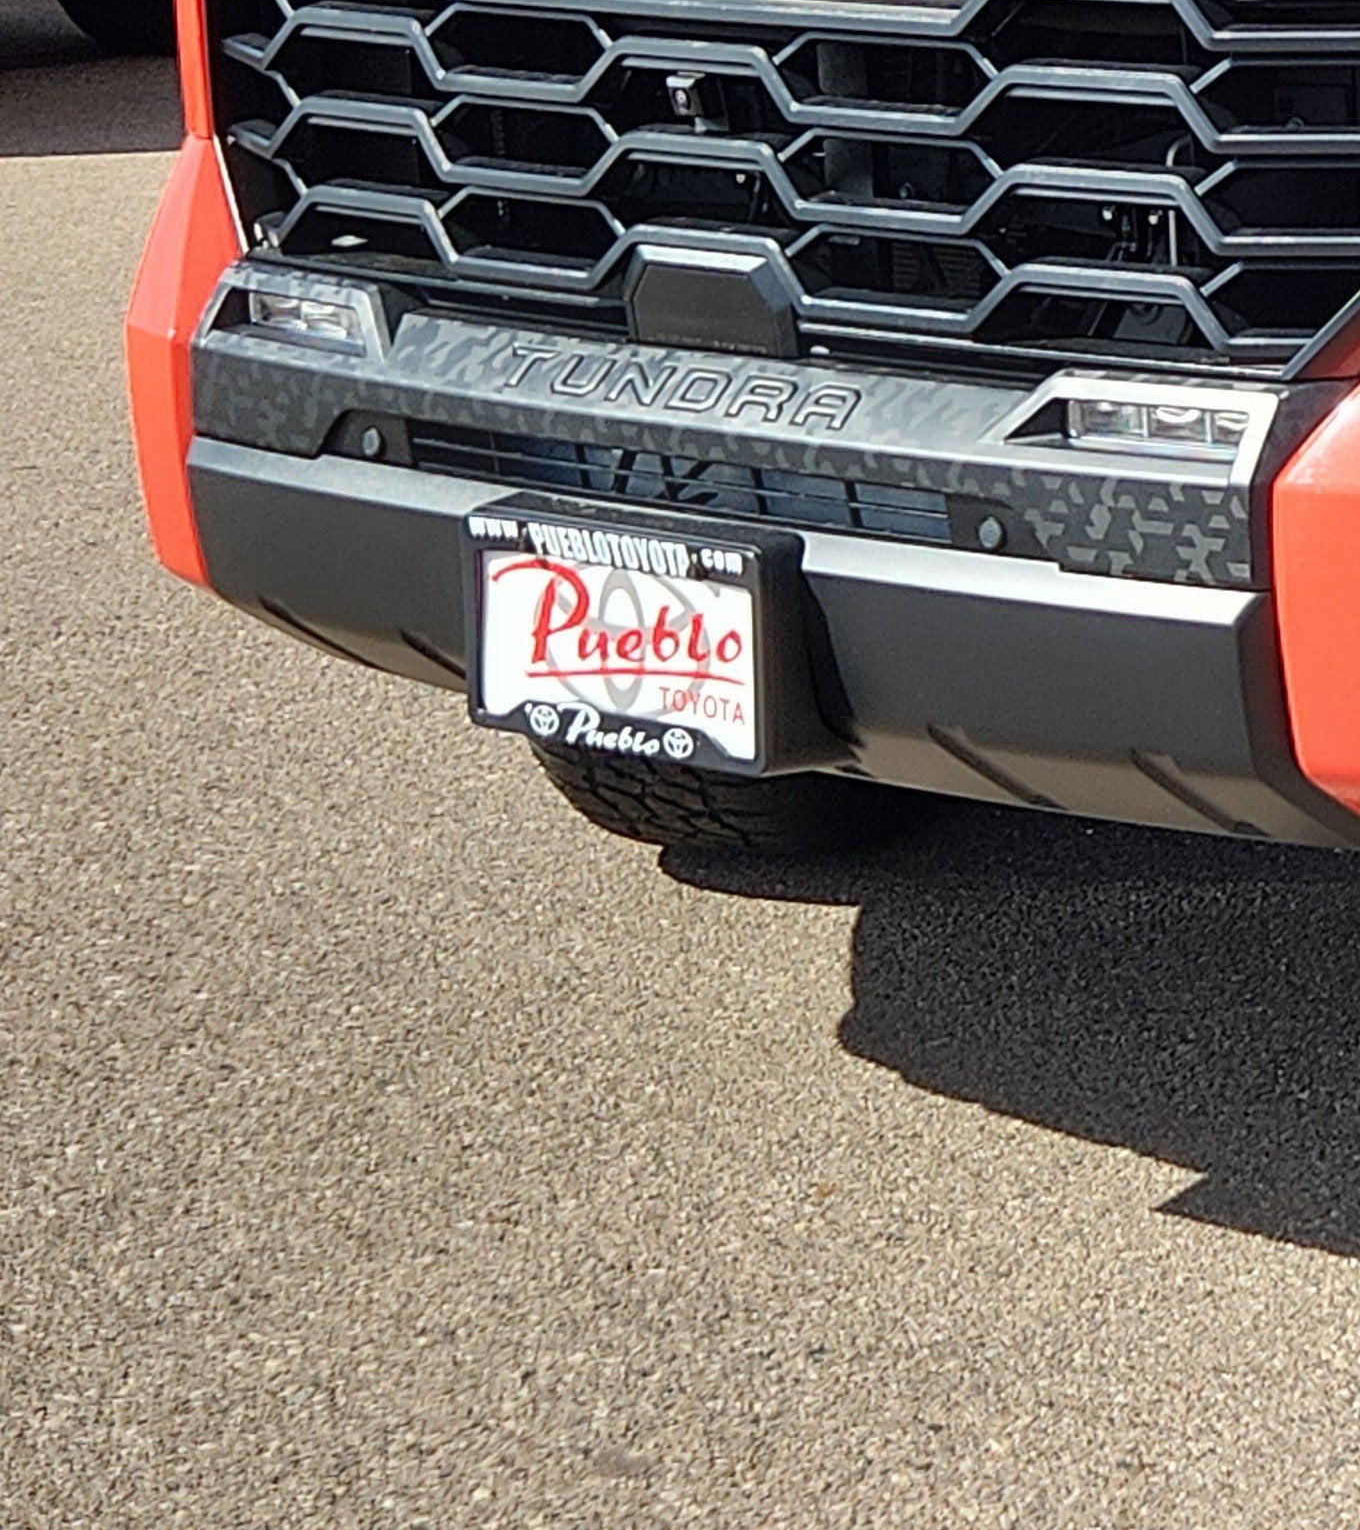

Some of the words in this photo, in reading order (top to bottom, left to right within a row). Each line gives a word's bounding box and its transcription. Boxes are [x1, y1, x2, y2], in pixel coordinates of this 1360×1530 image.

[504, 344, 863, 431] TUNDRA
[491, 557, 743, 664] Pueblo
[557, 700, 660, 756] Pueblo
[659, 686, 746, 726] TOYOTA
